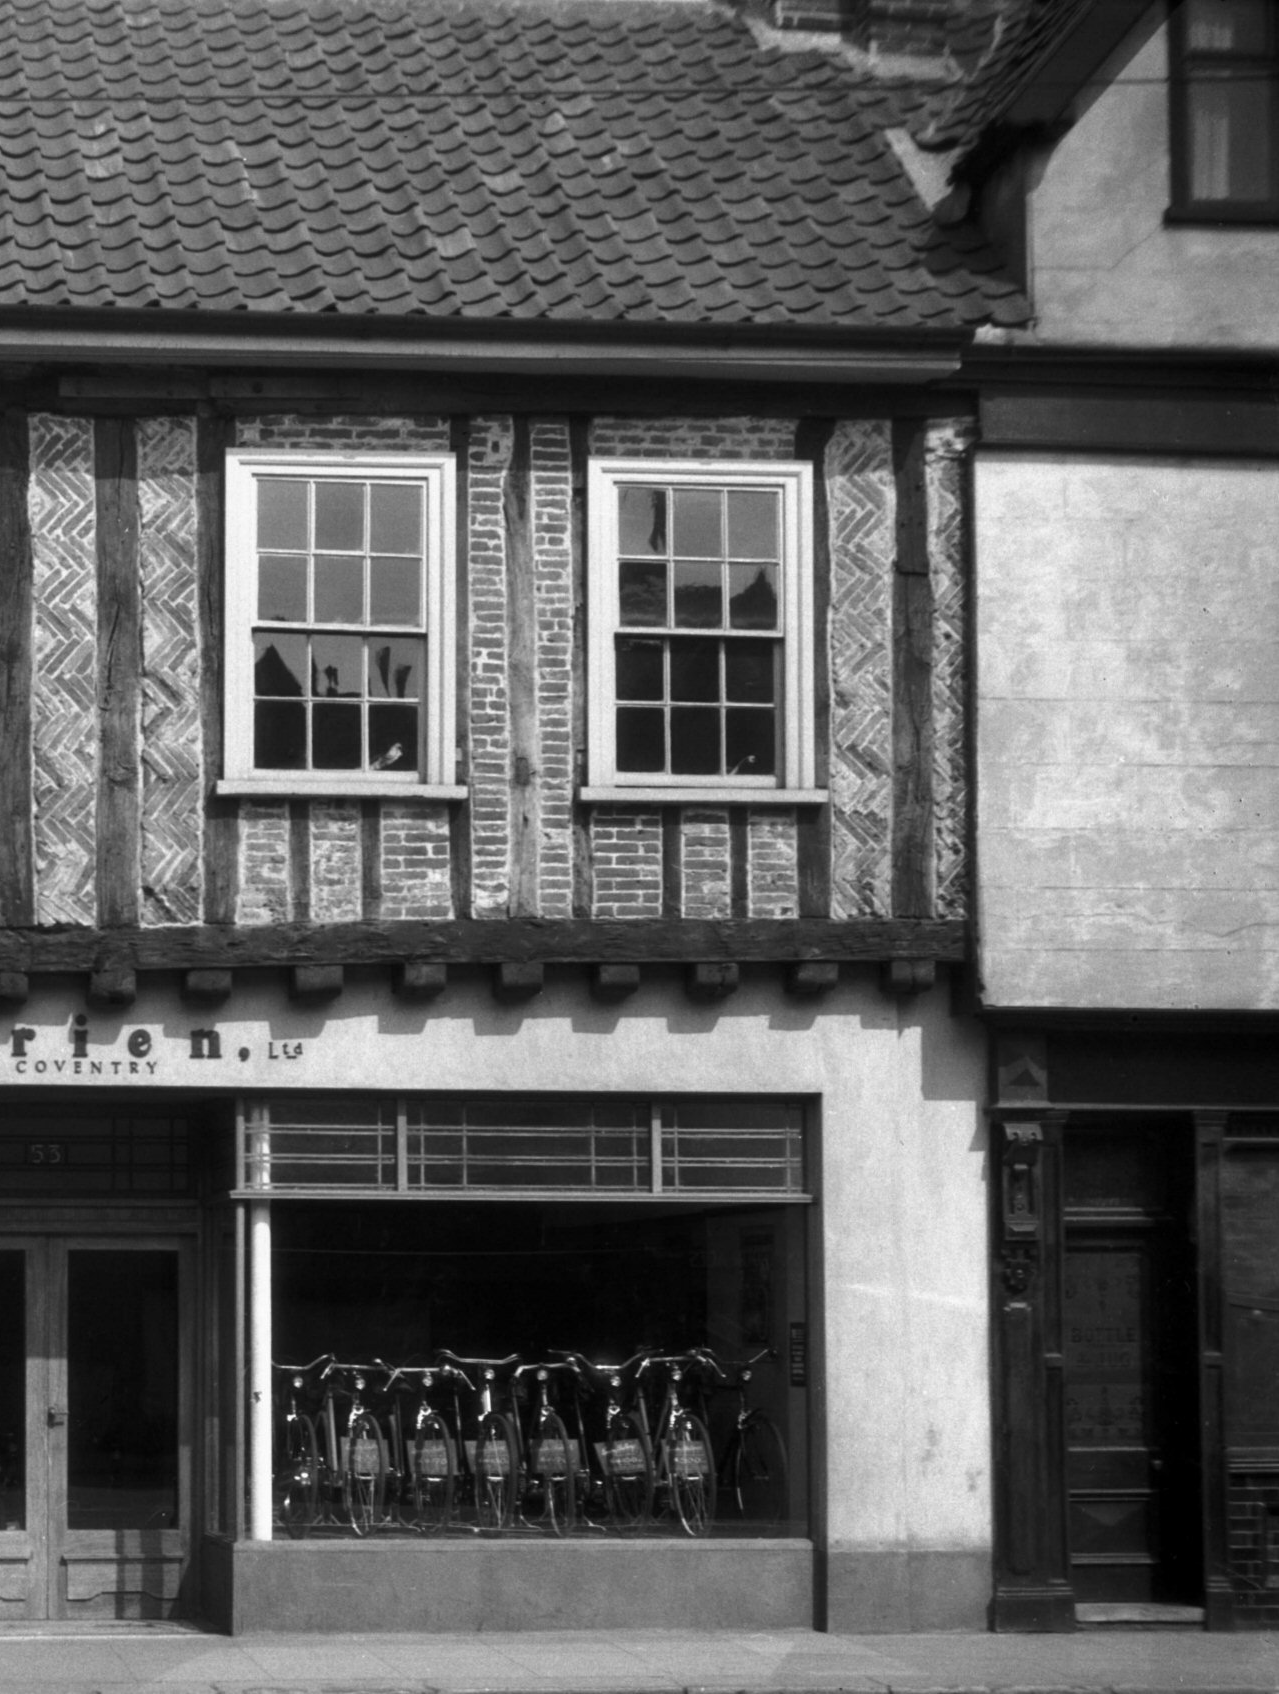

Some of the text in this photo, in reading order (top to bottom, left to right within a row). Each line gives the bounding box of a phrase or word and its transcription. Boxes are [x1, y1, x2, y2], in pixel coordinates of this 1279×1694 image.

[268, 1041, 303, 1060] Ltd
[15, 1060, 157, 1075] COVENTRY
[31, 1144, 61, 1164] 53
